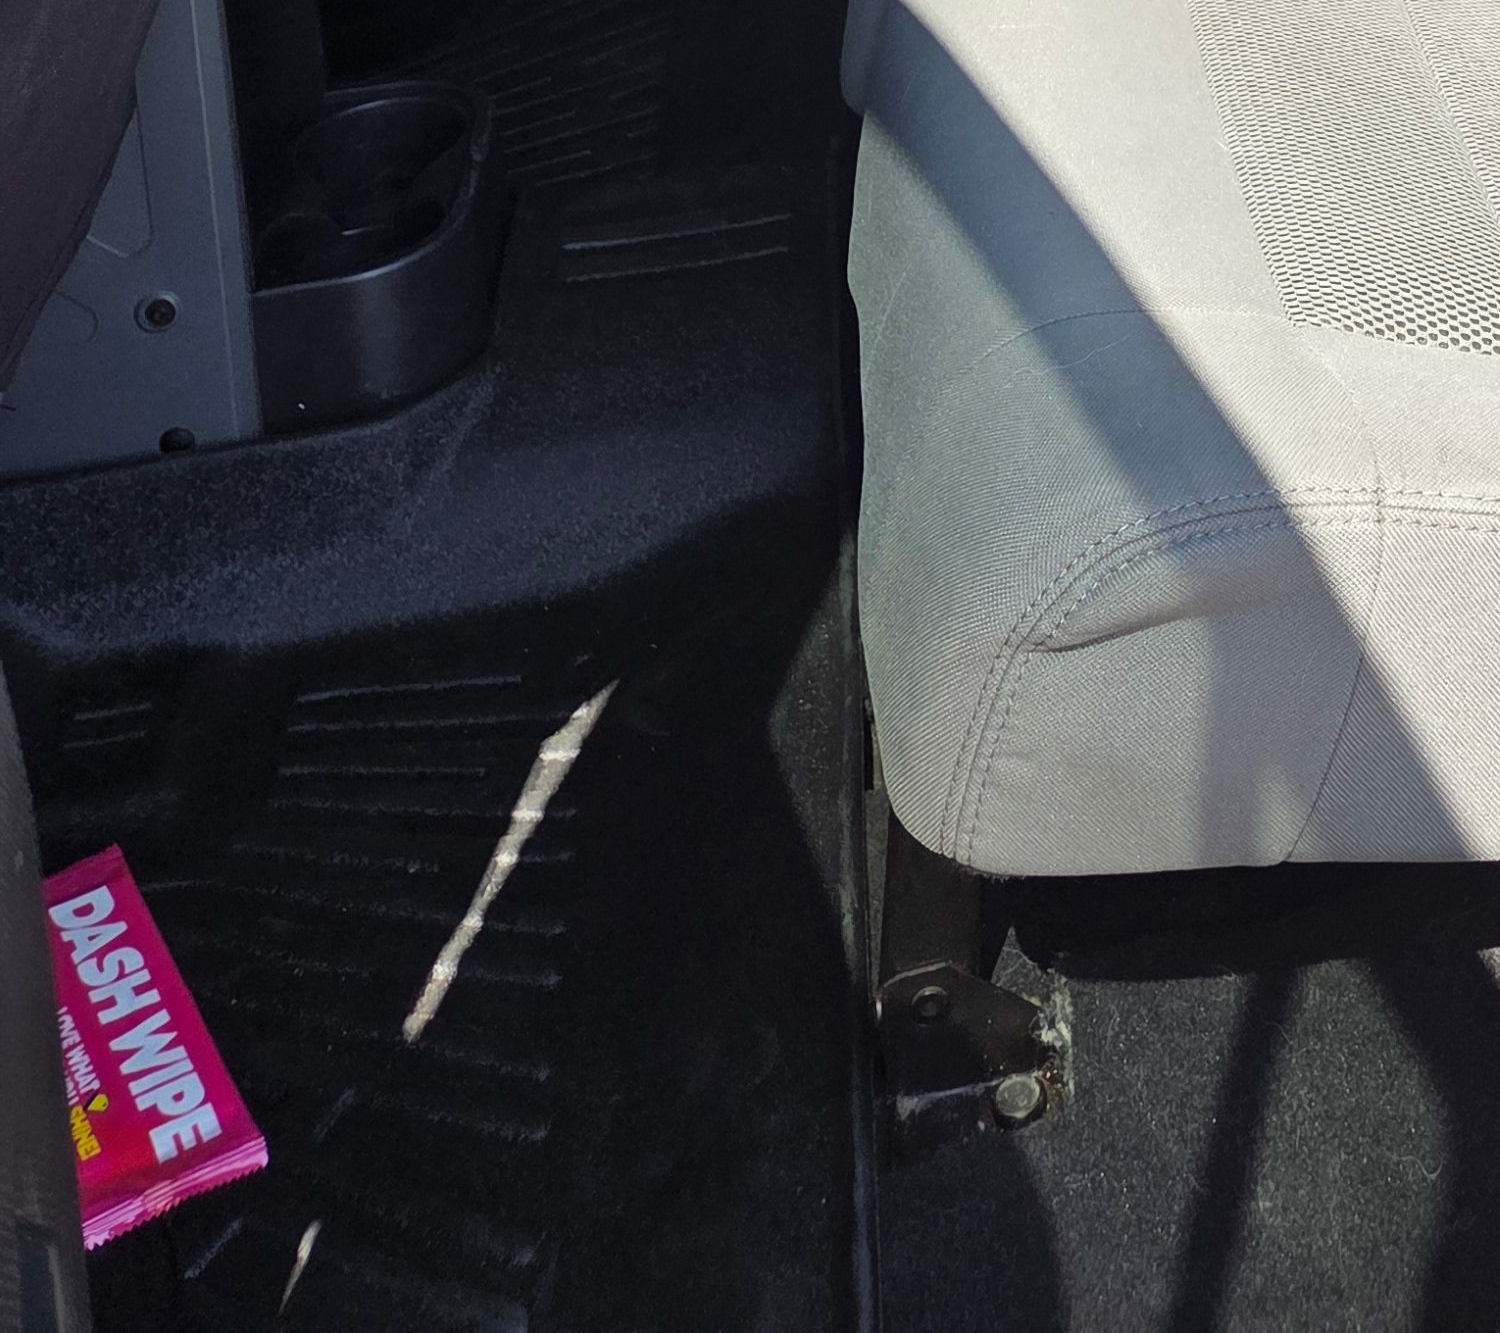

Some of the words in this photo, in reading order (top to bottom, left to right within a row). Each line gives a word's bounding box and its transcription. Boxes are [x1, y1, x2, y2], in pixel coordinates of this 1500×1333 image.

[48, 885, 161, 1025] DASH
[108, 1008, 222, 1165] WIPE
[65, 1043, 101, 1094] WHAT
